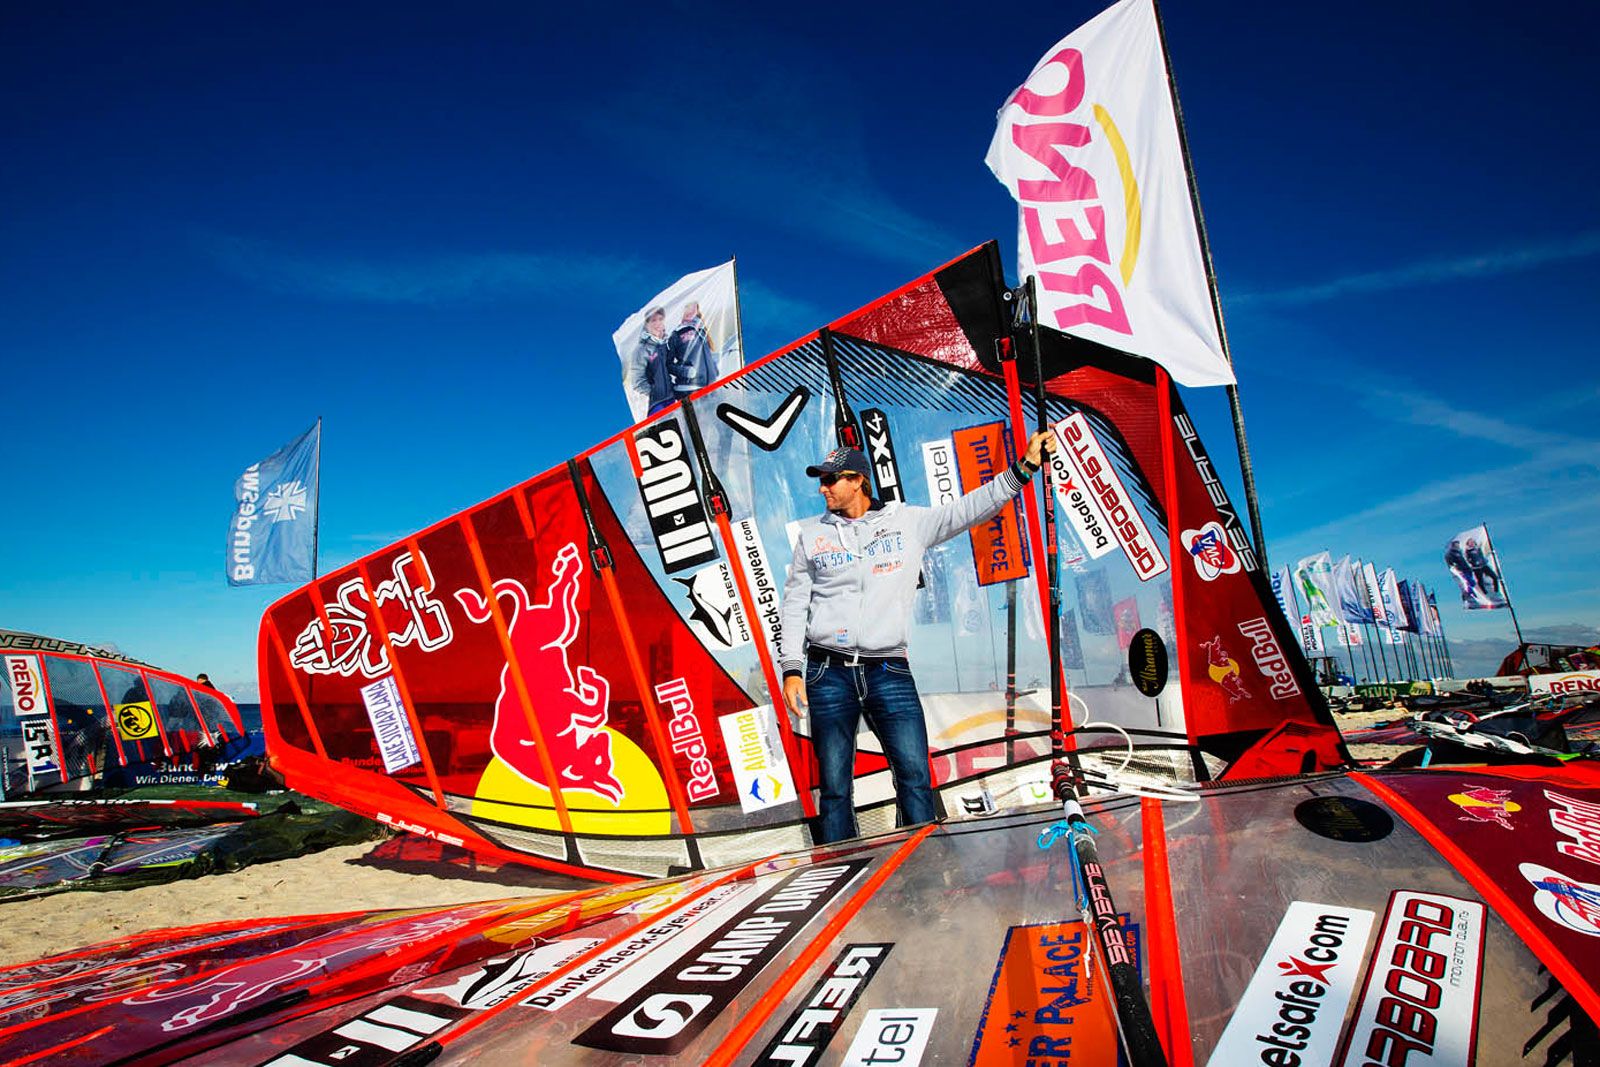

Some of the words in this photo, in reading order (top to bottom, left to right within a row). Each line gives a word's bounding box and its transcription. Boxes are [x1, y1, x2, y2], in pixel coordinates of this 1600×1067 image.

[719, 562, 736, 599] BENZ
[732, 603, 749, 642] CHRIS
[10, 659, 35, 712] RENO
[735, 713, 767, 772] Aldiana
[678, 914, 791, 982] CAMP
[756, 864, 850, 914] DAVID
